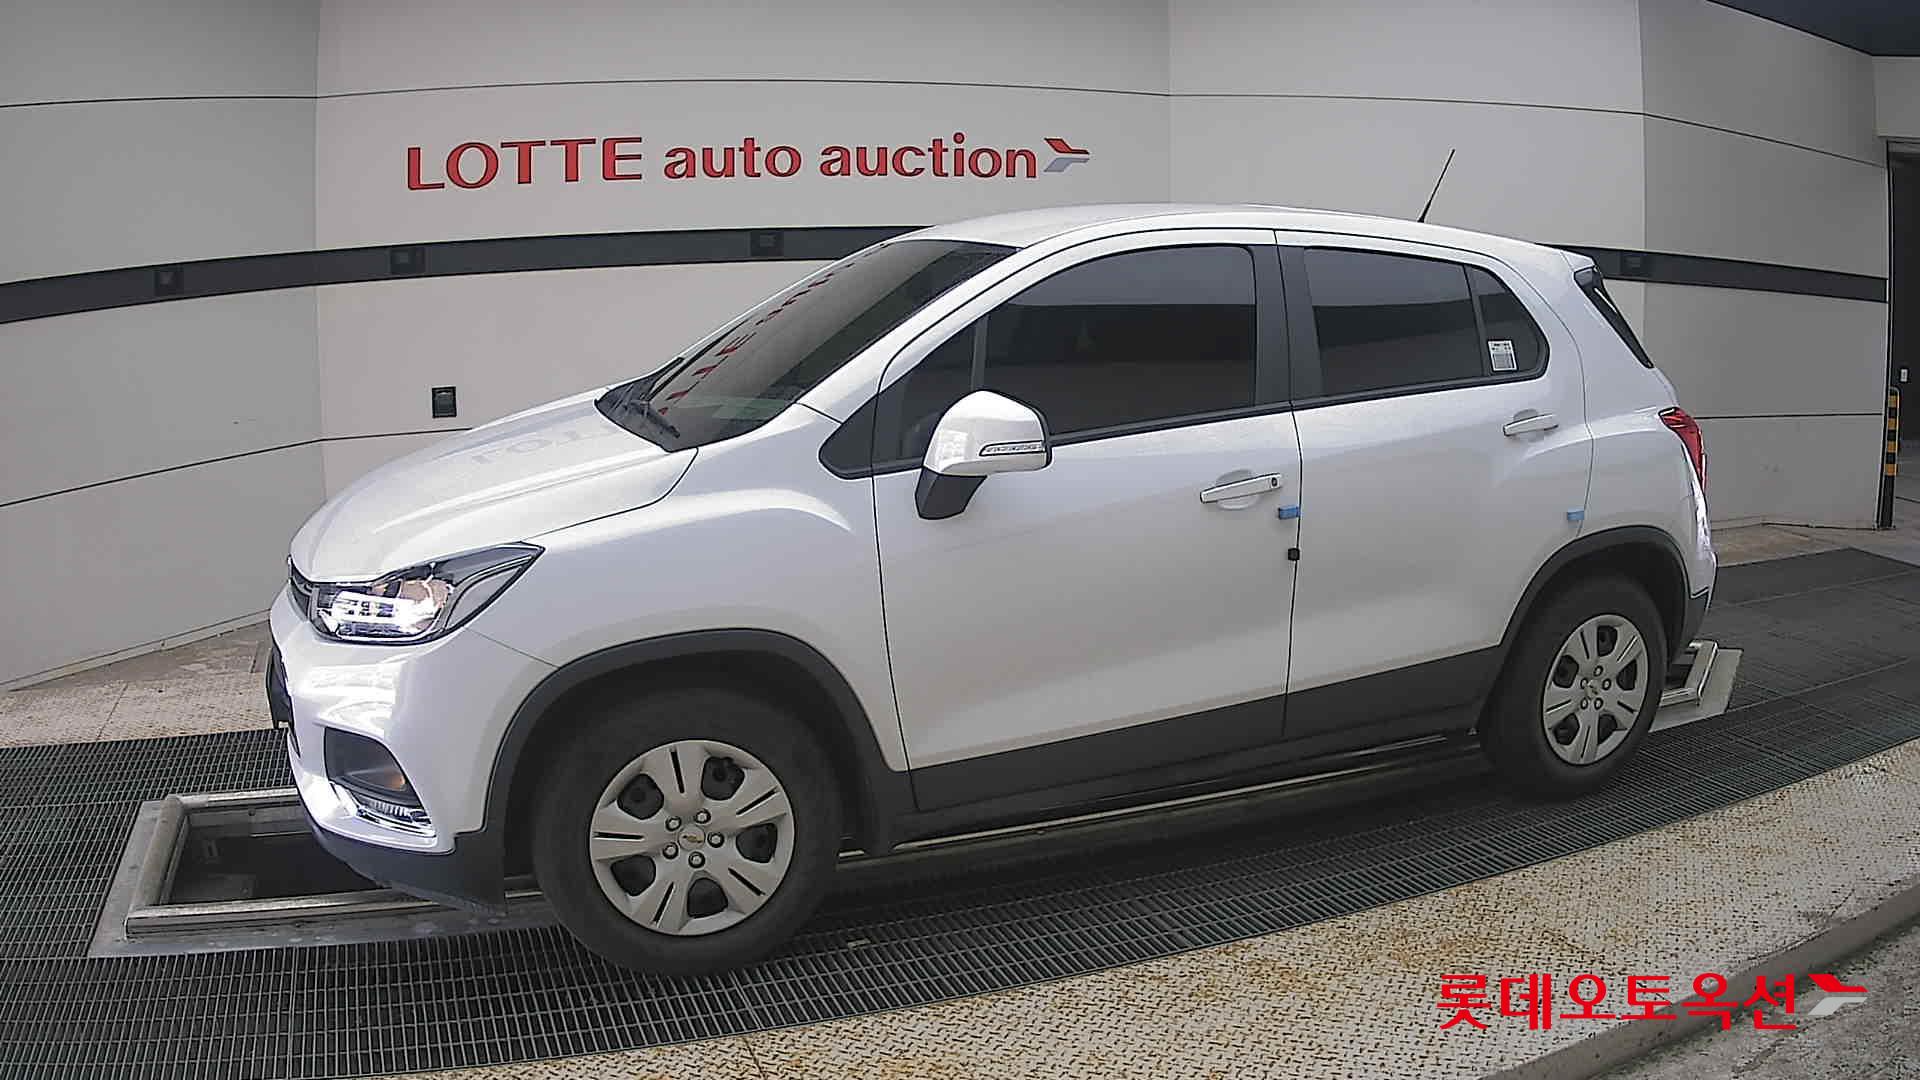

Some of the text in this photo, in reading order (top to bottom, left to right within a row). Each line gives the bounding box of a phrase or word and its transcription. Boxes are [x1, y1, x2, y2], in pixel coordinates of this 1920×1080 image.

[407, 132, 1037, 191] LOTTE auto auction
